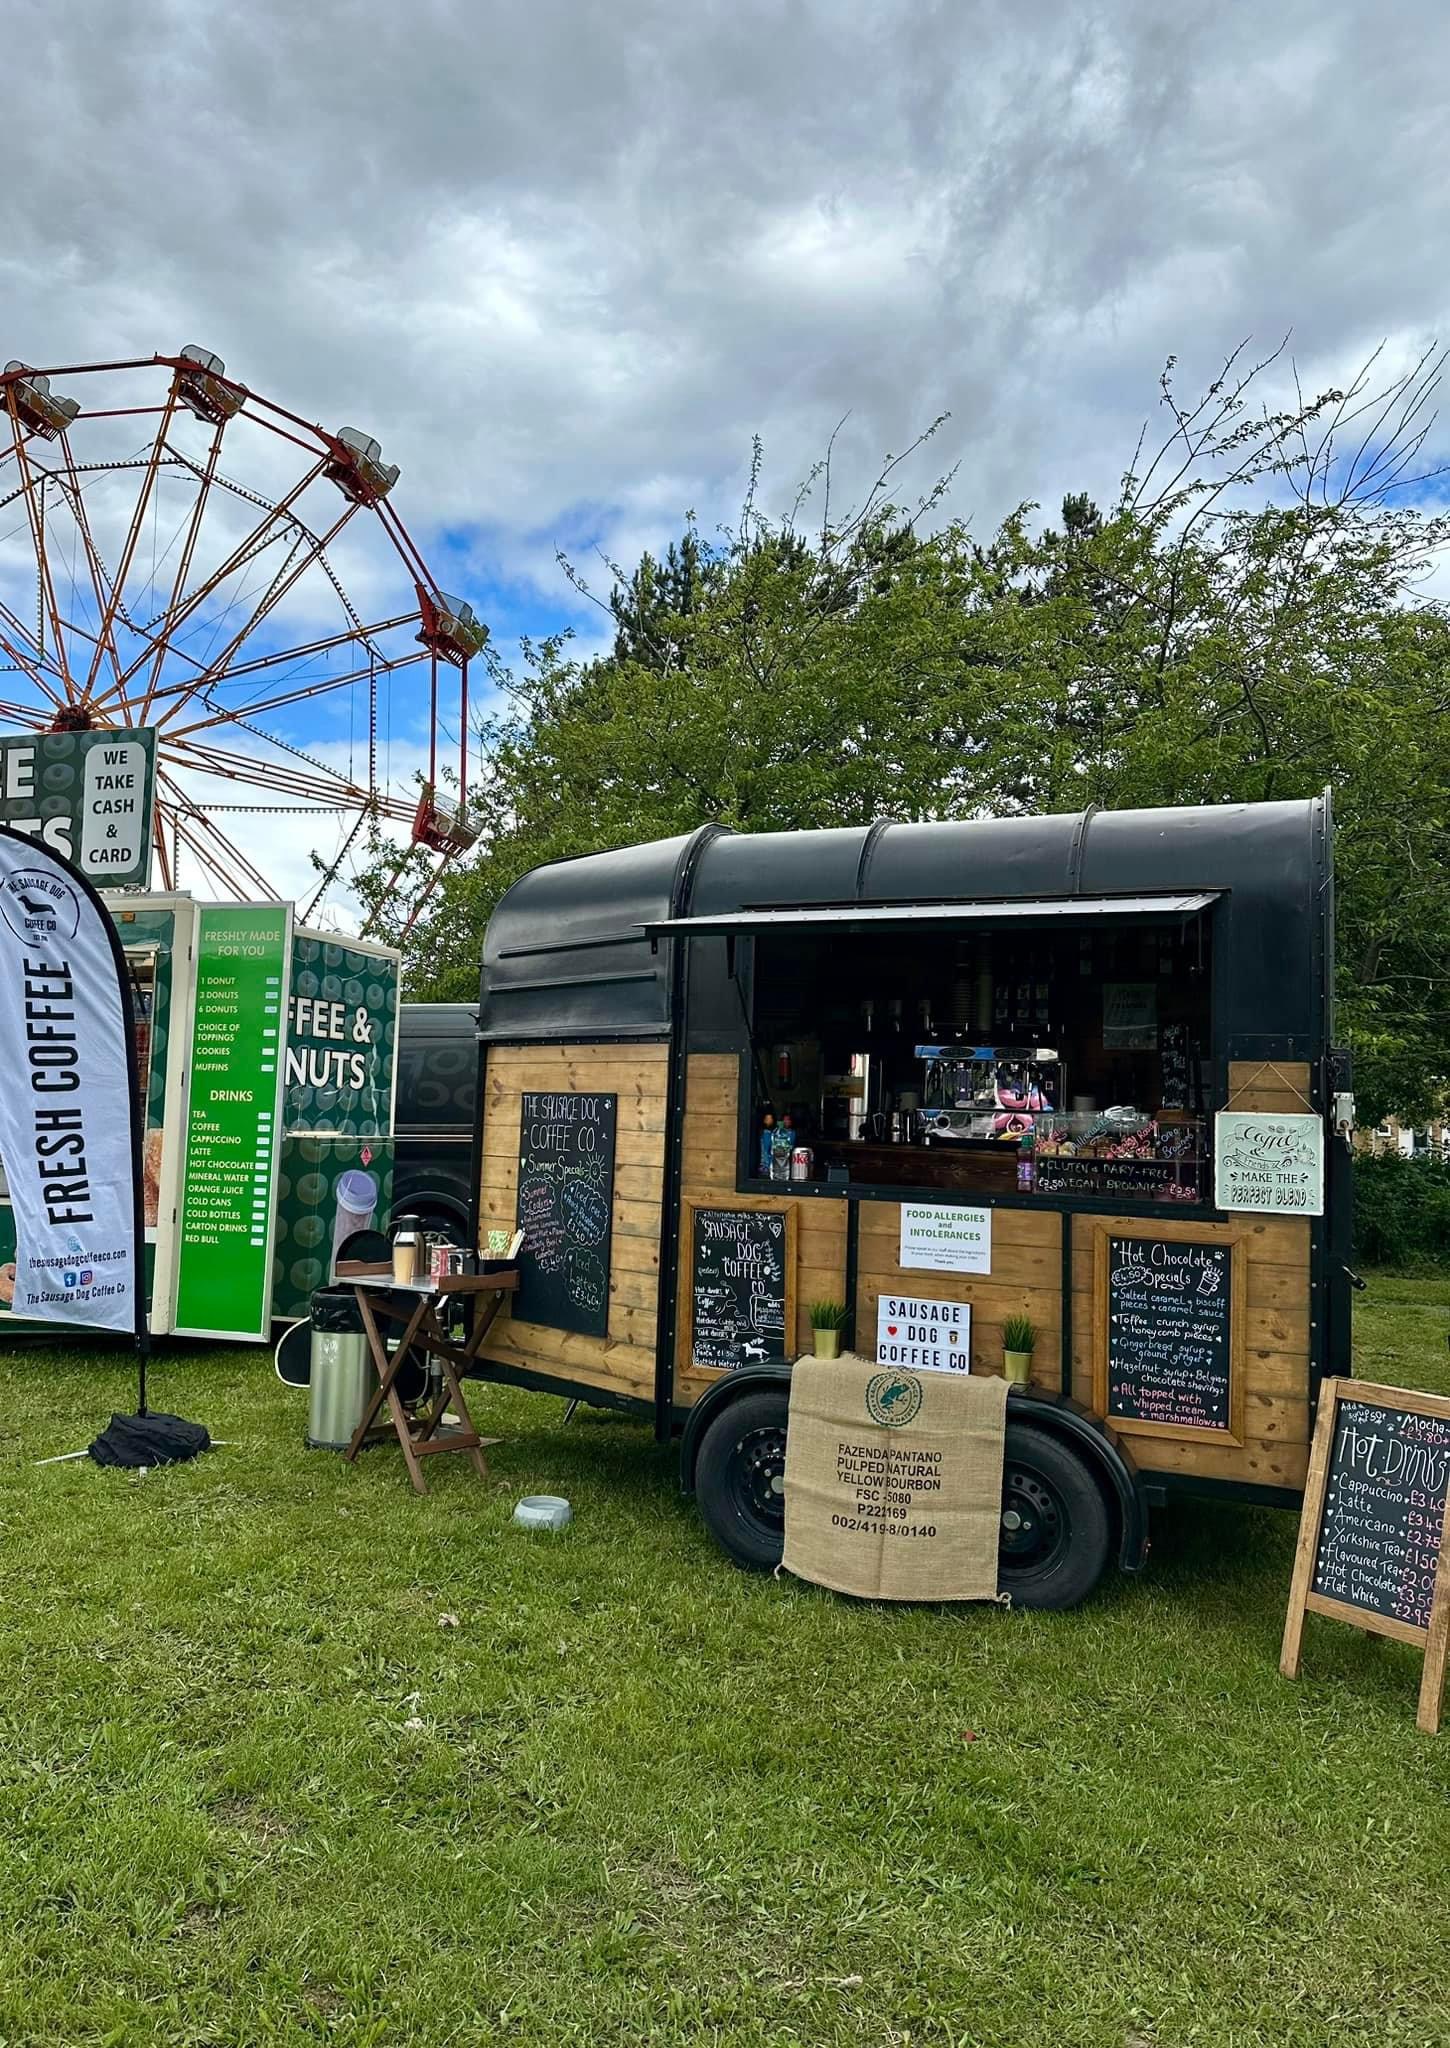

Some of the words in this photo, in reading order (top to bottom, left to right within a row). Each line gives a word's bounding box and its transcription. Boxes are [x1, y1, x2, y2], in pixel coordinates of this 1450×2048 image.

[104, 750, 129, 766] WE
[0, 747, 36, 799] E
[95, 774, 134, 791] TAKE
[93, 798, 134, 815] CASH
[106, 824, 118, 839] &
[89, 847, 132, 864] CARD
[205, 931, 248, 943] FRESHLY
[249, 930, 281, 942] MADE
[218, 945, 239, 957] FOR
[242, 945, 266, 957] YOU
[207, 977, 236, 986] DONUT
[206, 991, 239, 1000] DONUTS
[205, 1005, 238, 1014] DONUTS
[22, 957, 80, 1093] COFFEE
[197, 1023, 227, 1032] CHOICE
[229, 1023, 241, 1032] OF
[353, 1006, 373, 1044] &
[197, 1033, 235, 1042] TOPPINGS
[196, 1047, 231, 1056] COOKIES
[195, 1063, 229, 1072] MUFFINS
[285, 1047, 365, 1090] NUTS
[210, 1090, 254, 1102] DRINKS
[192, 1110, 207, 1119] TEA
[523, 1095, 540, 1119] THE
[540, 1095, 579, 1124] SAUSAGE
[581, 1097, 600, 1126] DOG
[192, 1123, 221, 1132] COFFEE
[190, 1135, 242, 1145] CAPPUCCINO
[530, 1123, 574, 1152] COFFEE
[190, 1147, 212, 1156] LATTE
[35, 1108, 94, 1226] FRESH
[189, 1160, 206, 1169] HOT
[207, 1161, 255, 1171] CHOCOLATE
[188, 1172, 222, 1181] MINERAL
[223, 1173, 250, 1183] WATER
[1106, 1179, 1165, 1193] BROWNIES
[1241, 1172, 1273, 1183] MAKE
[1276, 1173, 1298, 1184] THE
[188, 1185, 220, 1194] ORANGE
[222, 1186, 245, 1195] JUICE
[1231, 1185, 1273, 1205] PERFECT
[1275, 1187, 1306, 1207] BLEND
[187, 1197, 208, 1206] COLD
[210, 1198, 232, 1207] CANS
[186, 1209, 208, 1218] COLD
[209, 1210, 241, 1220] BOTTLES
[906, 1210, 933, 1219] FOOD
[934, 1212, 985, 1223] ALLERGIES
[185, 1222, 217, 1232] CARTON
[219, 1223, 248, 1233] DRINKS
[704, 1220, 752, 1242] SAUSAGE
[910, 1228, 981, 1241] INTOLERANCES
[184, 1234, 200, 1243] RED
[201, 1235, 220, 1245] BULL
[737, 1241, 762, 1262] DOG
[1119, 1241, 1145, 1266] Hot
[1151, 1244, 1213, 1268] Chocolate
[724, 1260, 763, 1280] COFFEE
[1143, 1268, 1191, 1289] Specials
[27, 1293, 40, 1305] The
[40, 1291, 74, 1304] Sausage
[76, 1288, 90, 1301] Dog
[91, 1285, 115, 1299] Coffee
[116, 1282, 126, 1294] Co
[1118, 1287, 1148, 1301] Salted
[1150, 1294, 1186, 1306] caramel
[1196, 1296, 1226, 1310] biscoff
[888, 1301, 960, 1323] SAUSAGE
[1120, 1300, 1148, 1311] pieces
[1158, 1304, 1195, 1315] caramel
[1198, 1308, 1225, 1319] sauce
[1117, 1312, 1148, 1325] Toffee
[1156, 1318, 1190, 1329] crunch
[1191, 1322, 1220, 1335] syrup
[908, 1325, 938, 1344] DOG
[1131, 1325, 1181, 1340] honeycomb
[1184, 1330, 1213, 1343] pieces
[1119, 1337, 1174, 1353] Gingerbread
[1178, 1345, 1205, 1356] syrup
[879, 1344, 941, 1367] COFFEE
[950, 1353, 966, 1370] CO
[1135, 1350, 1168, 1362] ground
[1170, 1353, 1204, 1367] ginger
[1114, 1357, 1161, 1374] Hazelnut
[1163, 1368, 1189, 1380] syrup
[1195, 1369, 1228, 1385] Belgian
[1121, 1382, 1137, 1396] All
[1139, 1387, 1177, 1401] topped
[1178, 1392, 1202, 1404] with
[1141, 1373, 1186, 1387] chocolate
[1187, 1380, 1224, 1397] shavings
[1175, 1404, 1206, 1416] cream
[1341, 1402, 1357, 1411] Add
[1150, 1412, 1217, 1428] marshmallows
[1401, 1414, 1445, 1434] Mocha
[838, 1443, 889, 1460] FAZENDA
[889, 1449, 943, 1463] PANTANO
[837, 1457, 885, 1474] PULPED
[887, 1463, 942, 1477] NATURAL
[836, 1470, 885, 1487] YELLOW
[886, 1476, 941, 1491] BOURBON
[1338, 1472, 1403, 1503] Cappuccino
[856, 1488, 880, 1502] FSC
[1338, 1491, 1374, 1515] Latte
[1334, 1506, 1396, 1534] Americano
[1406, 1529, 1441, 1549] £2.75
[1332, 1525, 1381, 1551] Yorkshire
[1382, 1541, 1401, 1556] Tea
[1326, 1542, 1379, 1571] Flavoured
[1379, 1559, 1399, 1577] Tea
[1326, 1560, 1349, 1577] Hot
[1351, 1569, 1399, 1595] Chocolate
[1323, 1576, 1349, 1595] Flat
[1351, 1583, 1381, 1608] White
